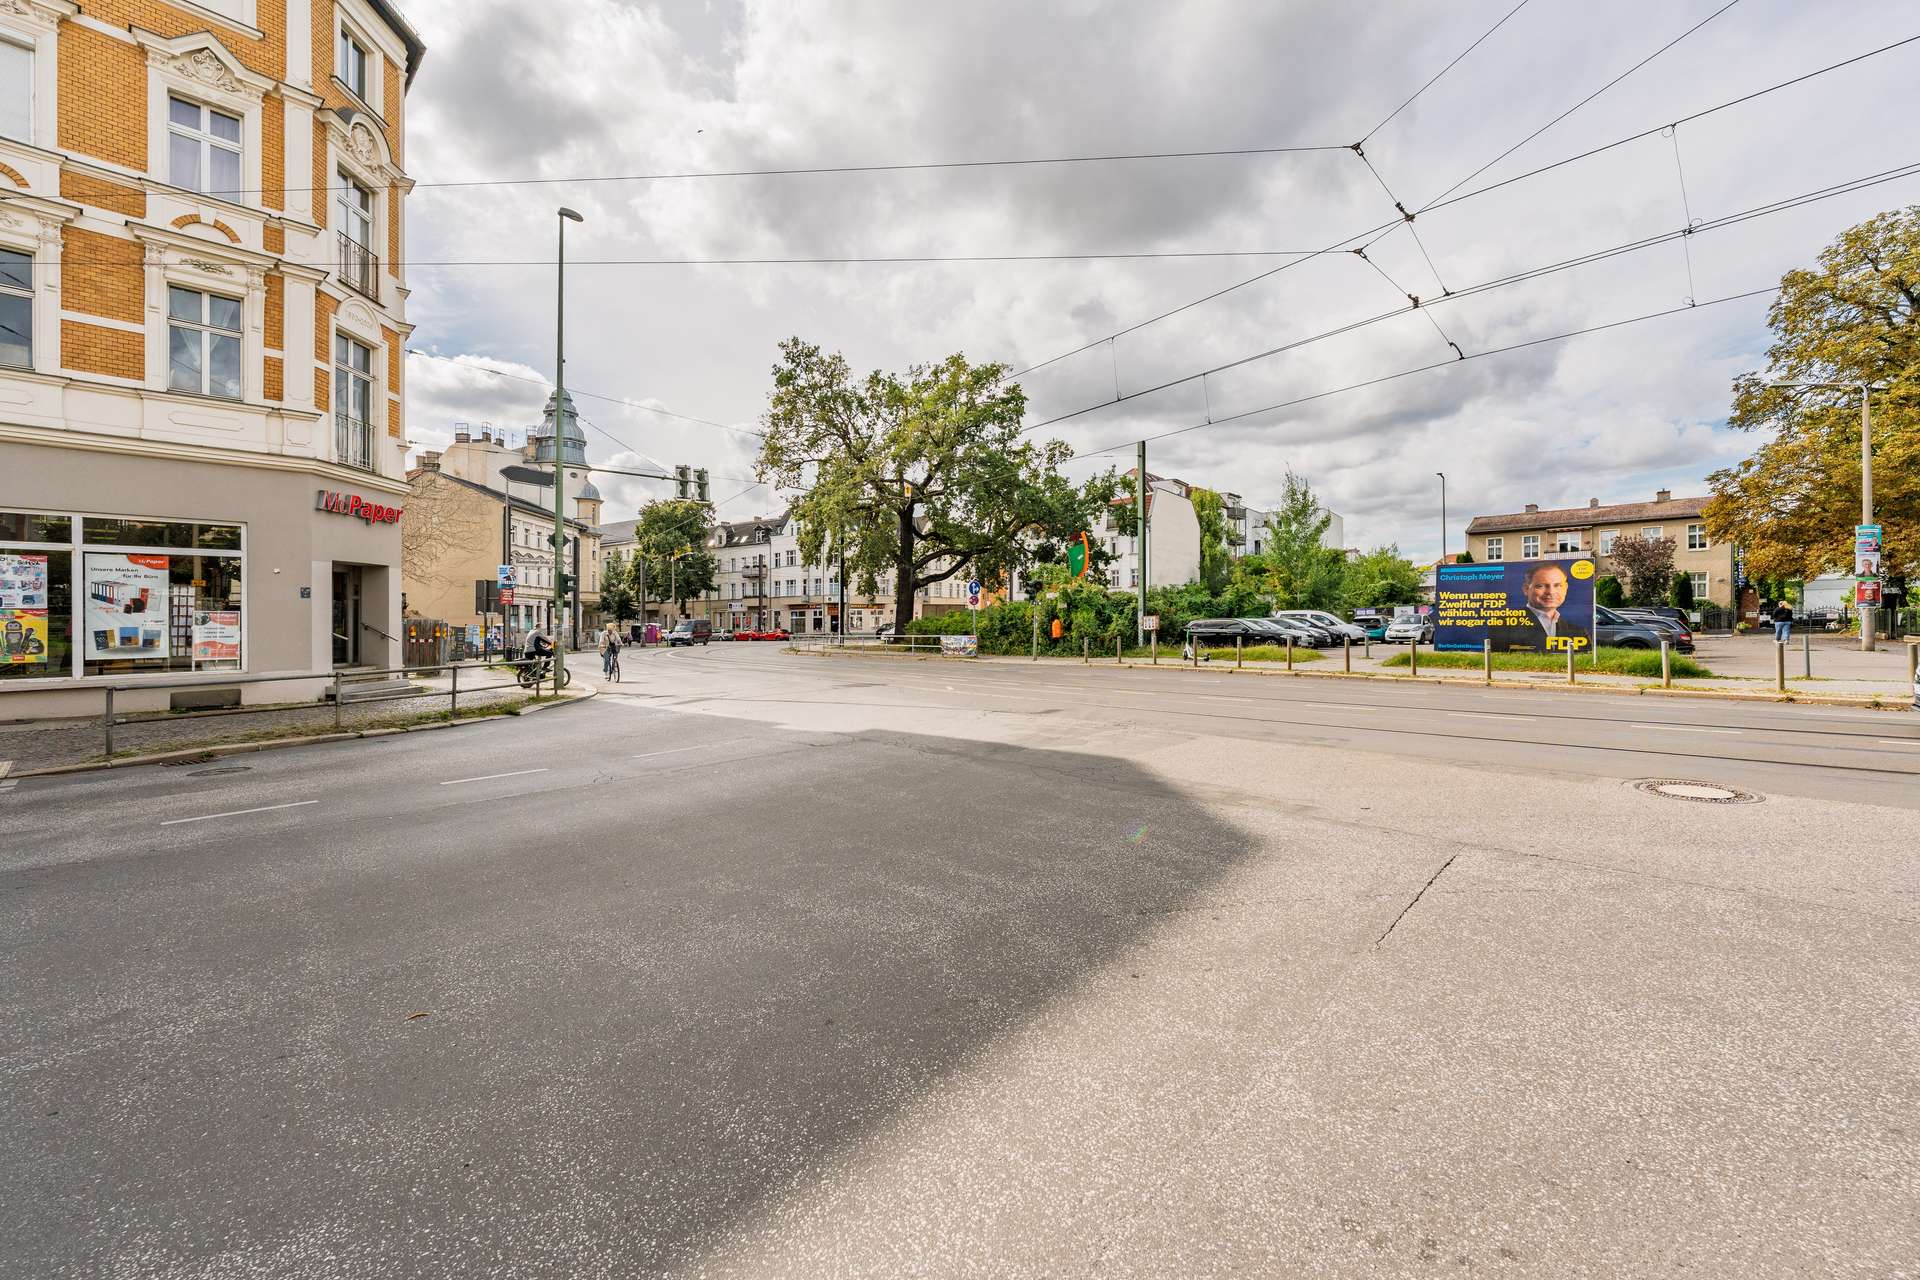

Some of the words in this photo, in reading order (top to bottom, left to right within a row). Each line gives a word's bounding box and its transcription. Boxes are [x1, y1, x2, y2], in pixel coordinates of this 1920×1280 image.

[1440, 574, 1478, 582] Christoph
[1478, 573, 1504, 581] Meyer
[1439, 600, 1482, 608] Zweifler
[1483, 600, 1507, 608] FDP
[1439, 609, 1478, 618] wählen,
[1480, 608, 1526, 617] knacken
[1439, 618, 1455, 626] wir
[1455, 619, 1484, 628] sogar
[1487, 617, 1503, 626] die
[1506, 617, 1518, 626] 10
[1546, 636, 1588, 650] FDP
